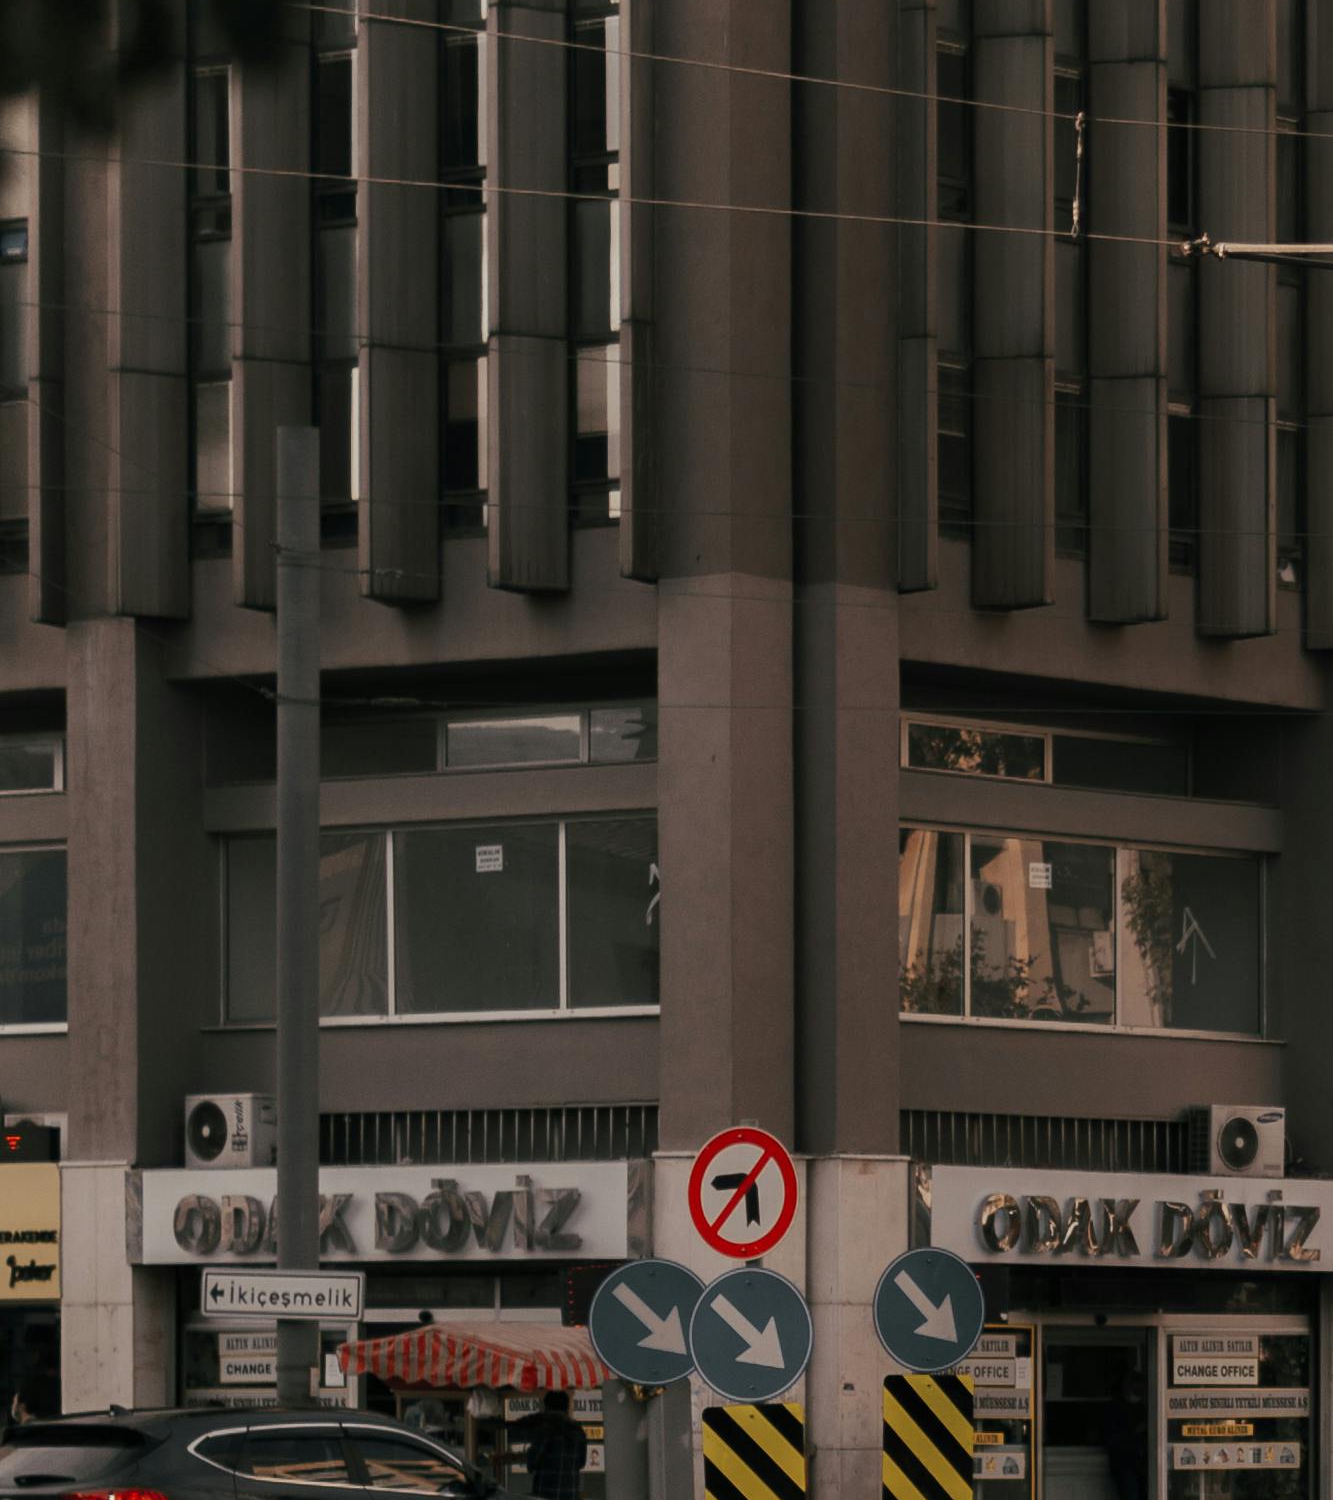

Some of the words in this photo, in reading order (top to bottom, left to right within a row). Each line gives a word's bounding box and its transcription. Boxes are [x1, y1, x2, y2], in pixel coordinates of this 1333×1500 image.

[375, 1174, 583, 1254] DÖVİZ
[977, 1191, 1141, 1257] ODAK
[1154, 1188, 1322, 1262] DÖVİZ
[230, 1280, 353, 1308] İkiçeşmelik
[226, 1363, 272, 1375] CHANGE
[974, 1367, 1009, 1378] OFFICE
[1177, 1365, 1218, 1377] CHANGE
[1220, 1365, 1255, 1377] OFFICE
